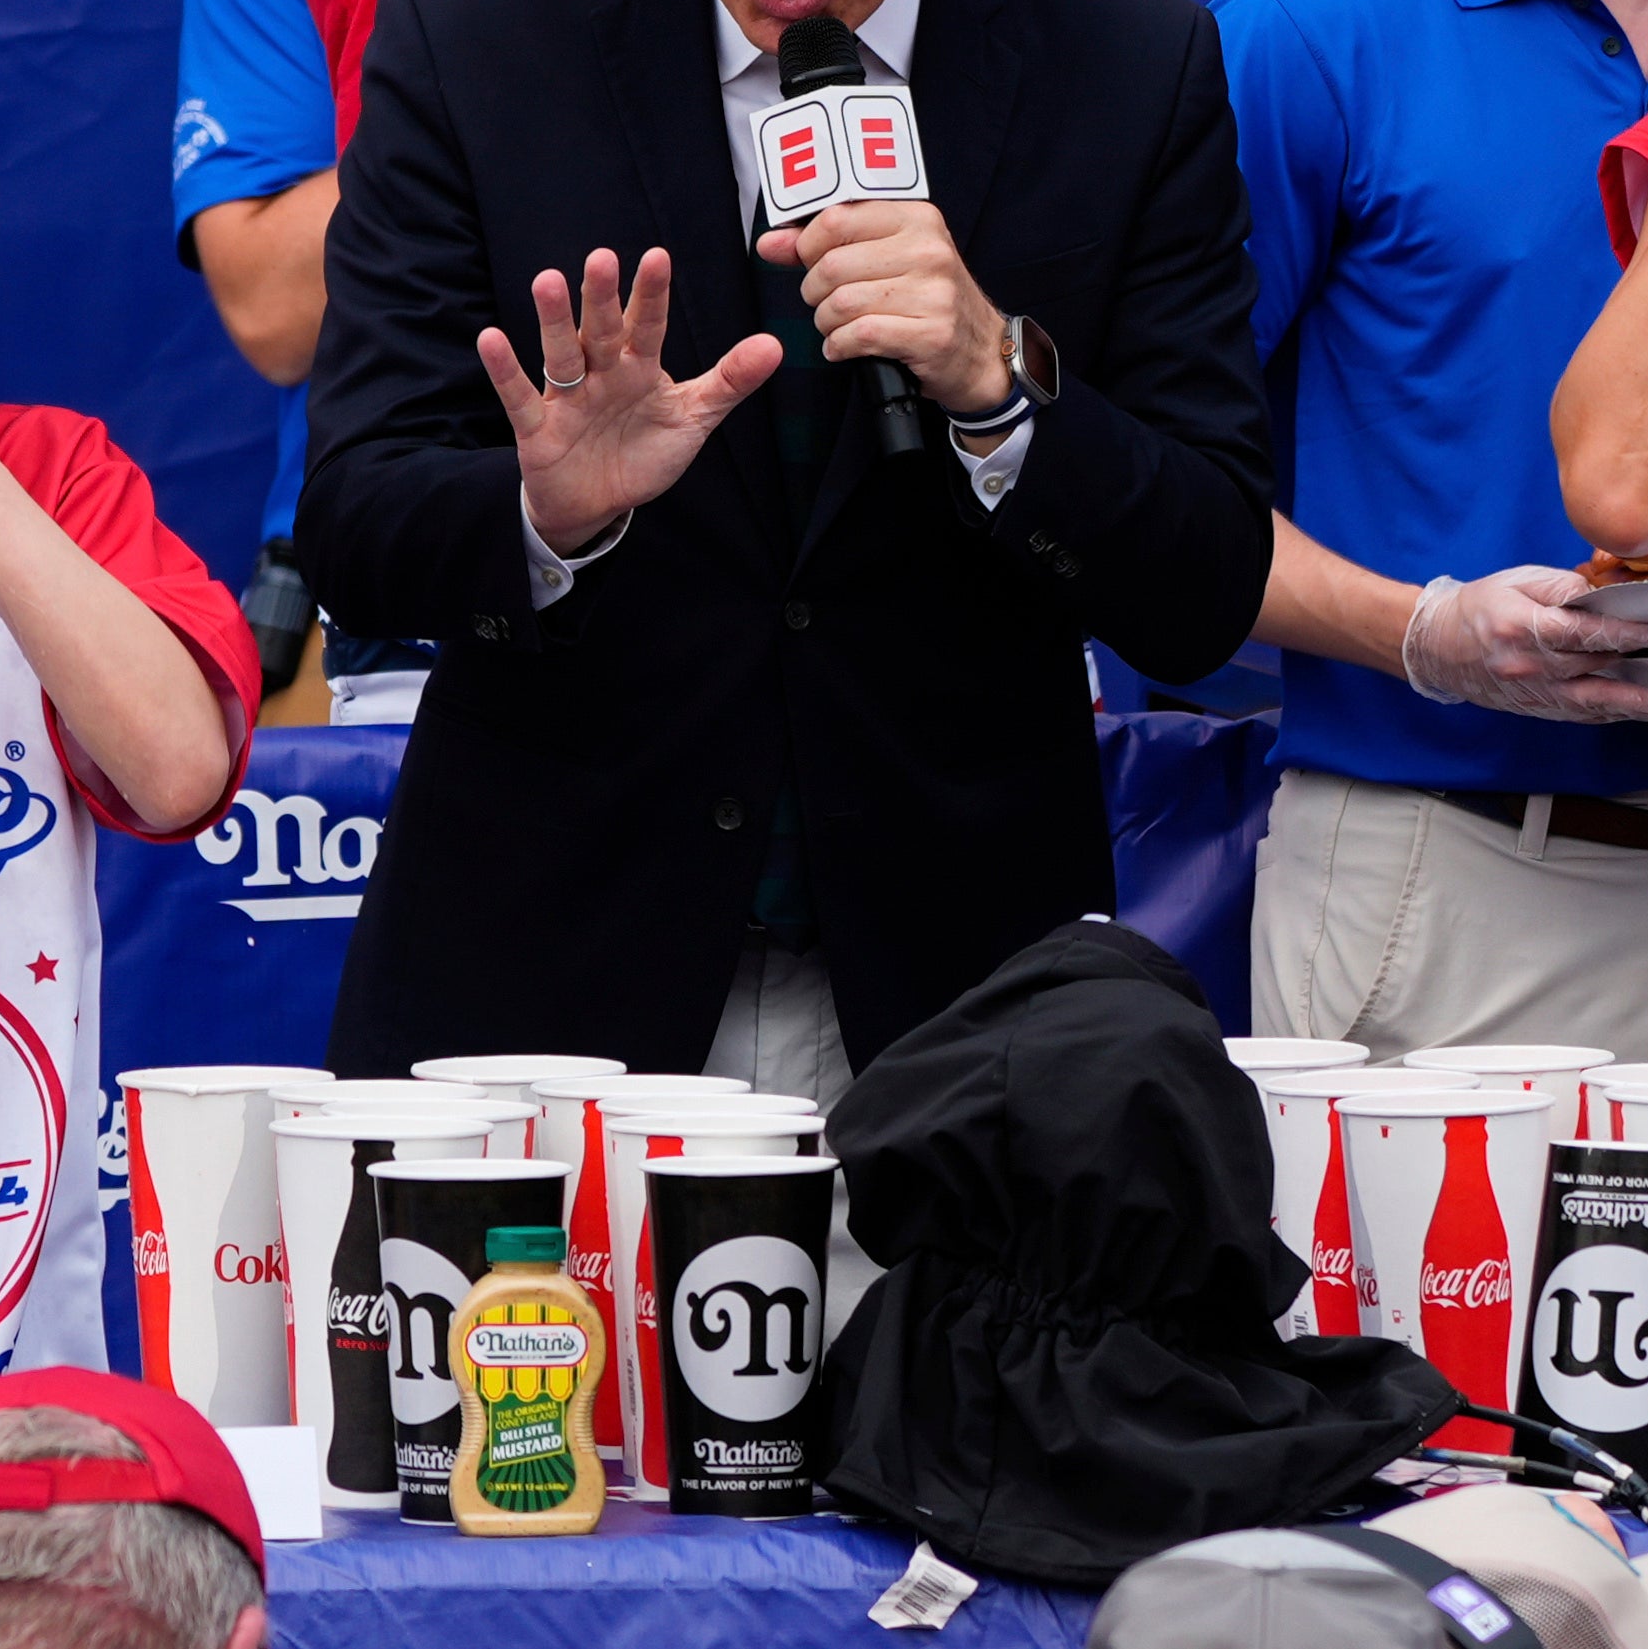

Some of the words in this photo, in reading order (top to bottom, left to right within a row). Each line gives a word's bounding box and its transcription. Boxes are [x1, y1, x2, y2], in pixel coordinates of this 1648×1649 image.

[1576, 1173, 1604, 1186] NEW
[1606, 1175, 1624, 1187] OF
[214, 1244, 283, 1285] Cok
[1421, 1259, 1512, 1309] Coca-Cola
[476, 1331, 578, 1352] Nathan's
[514, 1402, 558, 1418] ORIGINAL
[500, 1427, 523, 1442] DELI
[525, 1422, 555, 1439] STYLE
[491, 1434, 563, 1462] MUSTARD
[693, 1438, 802, 1465] Nathan's
[700, 1479, 747, 1491] FLAVOR
[749, 1480, 766, 1490] OF
[768, 1479, 793, 1490] NEW
